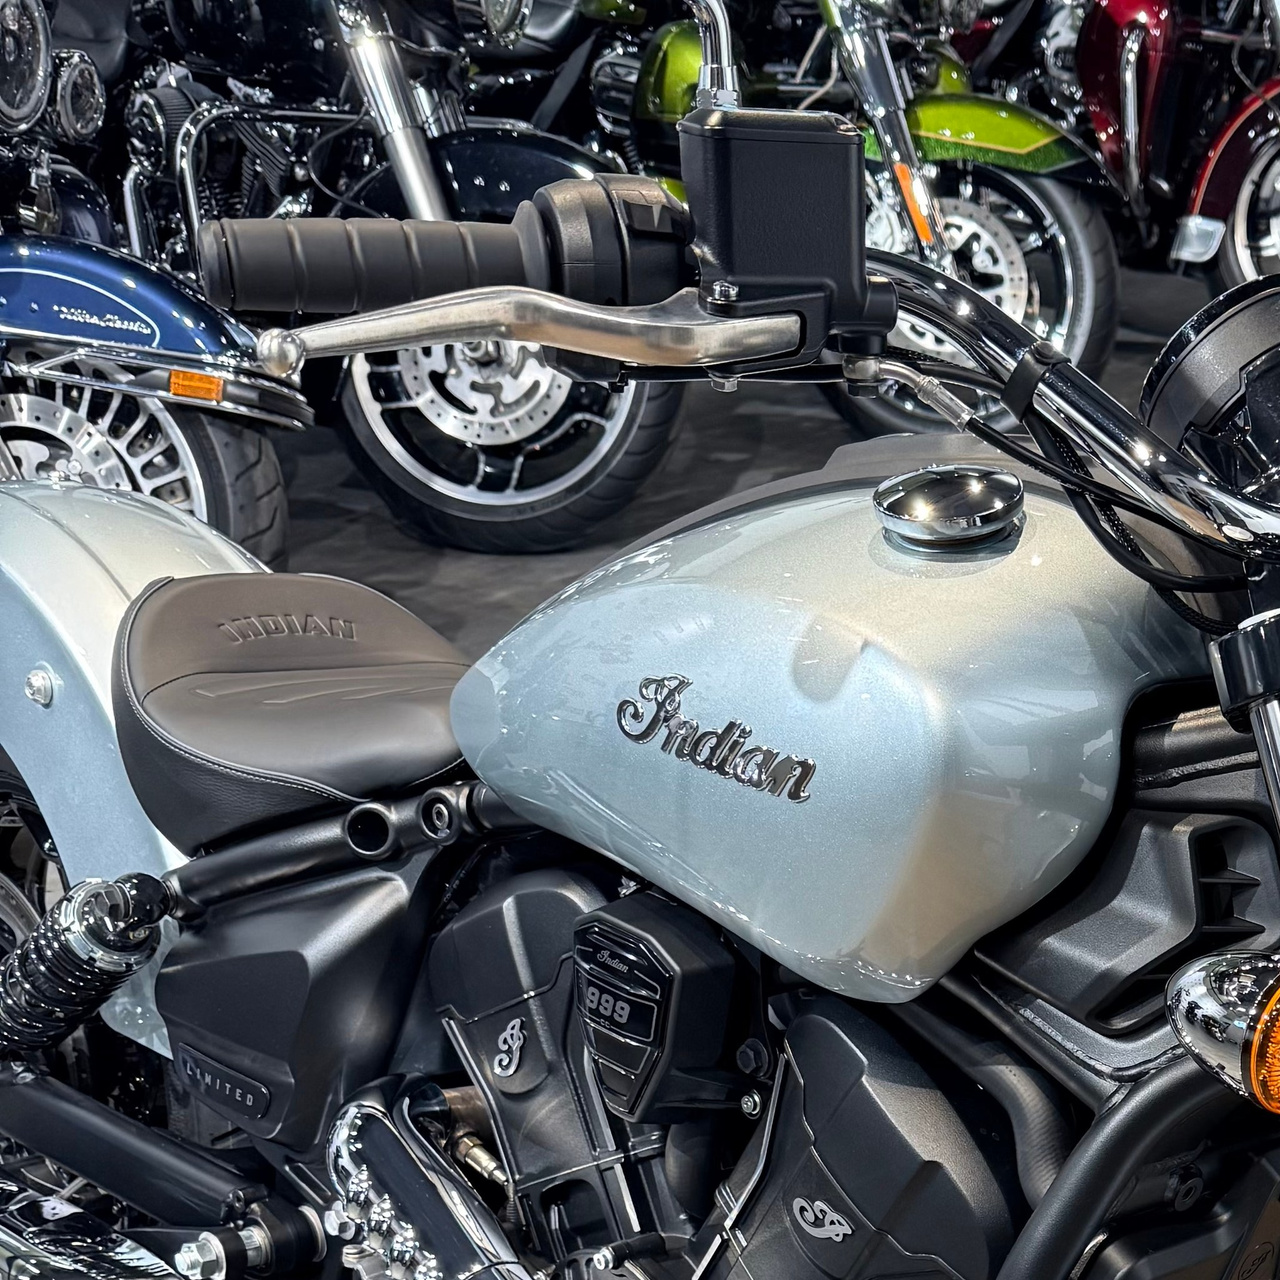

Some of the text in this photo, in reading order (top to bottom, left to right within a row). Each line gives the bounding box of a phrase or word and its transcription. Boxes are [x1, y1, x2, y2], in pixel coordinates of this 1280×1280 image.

[217, 604, 357, 645] INDIAN
[616, 672, 817, 804] Indian
[597, 950, 629, 973] Indian
[586, 986, 631, 1024] 999
[186, 1062, 254, 1107] LIMITED
